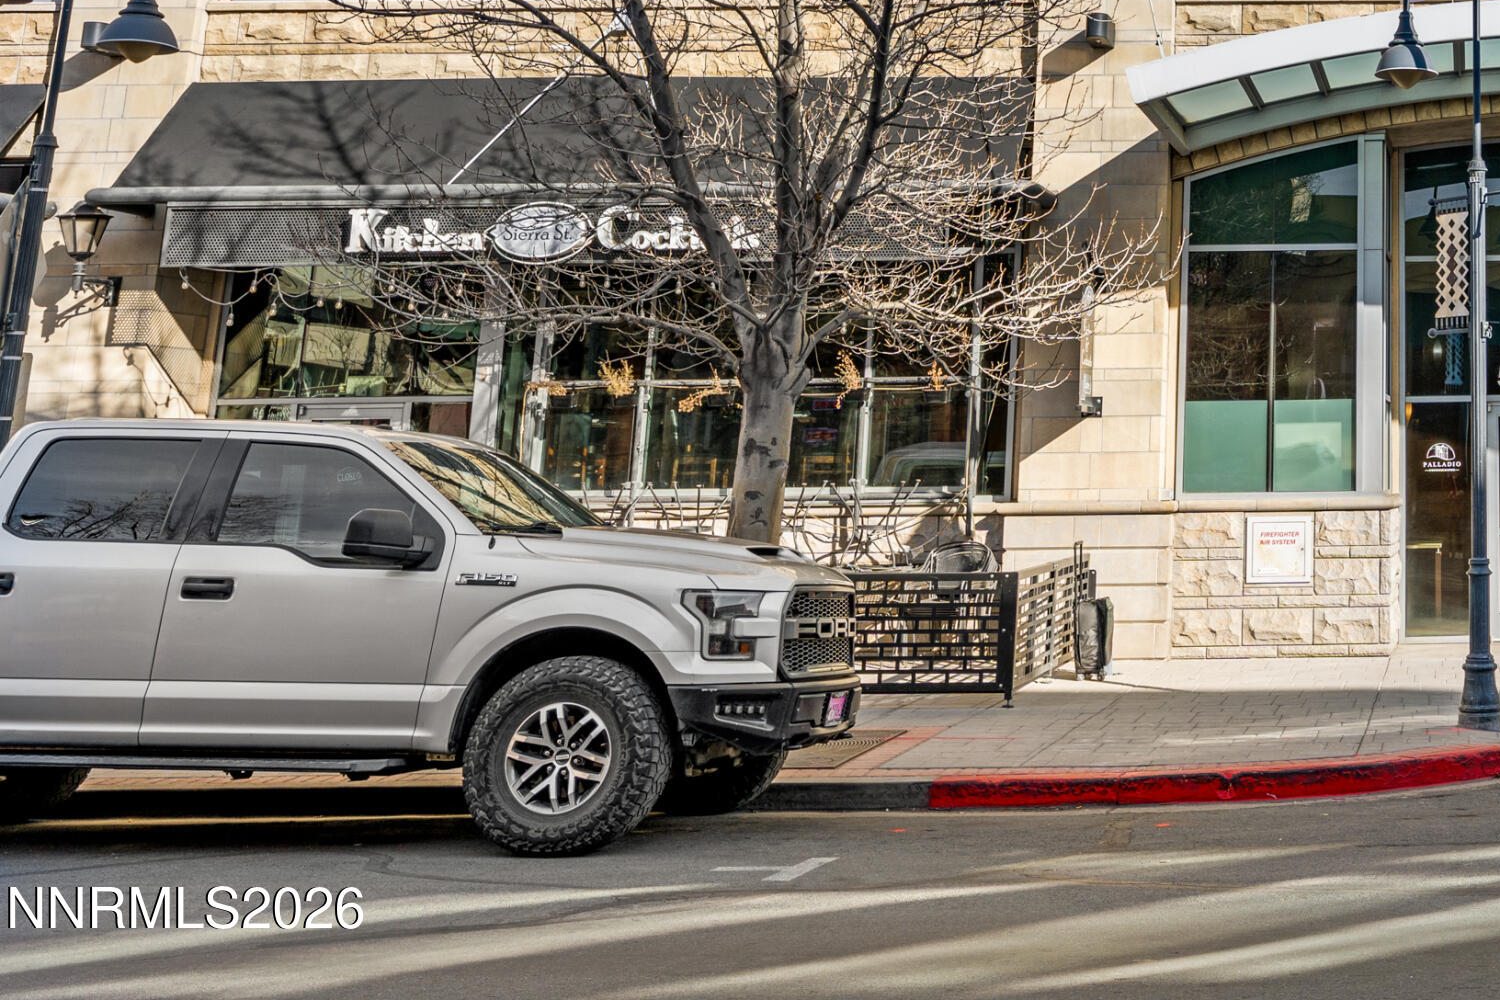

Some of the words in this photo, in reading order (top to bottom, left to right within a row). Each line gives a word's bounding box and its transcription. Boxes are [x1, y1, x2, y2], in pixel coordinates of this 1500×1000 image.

[344, 208, 486, 253] Kitchen
[503, 225, 549, 240] Sierra
[553, 223, 572, 241] St.
